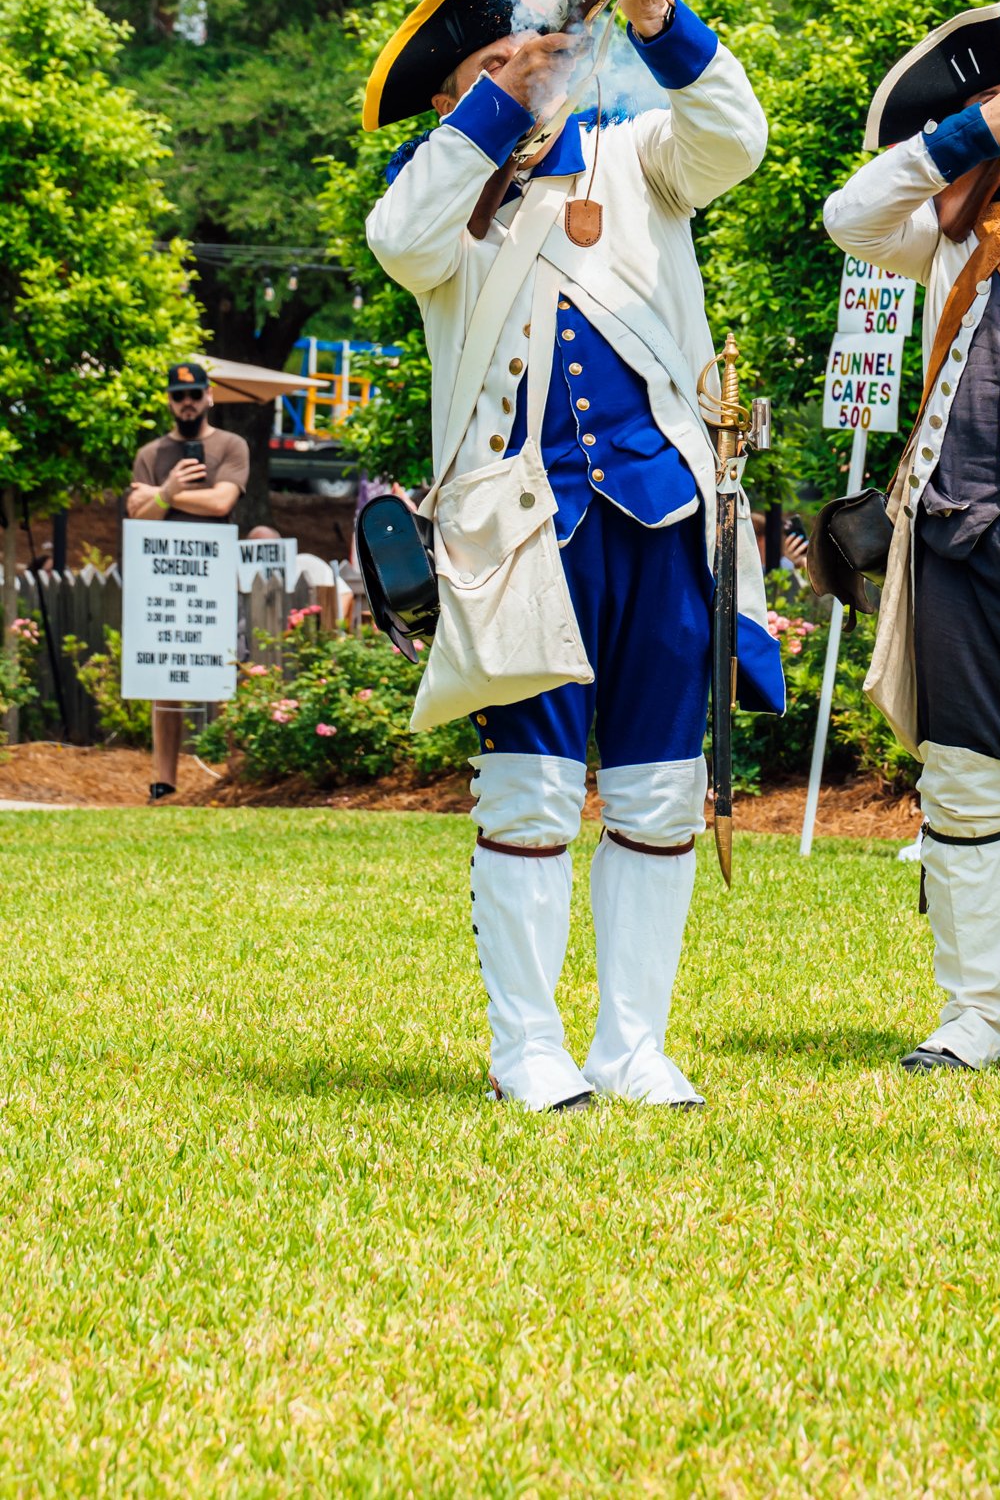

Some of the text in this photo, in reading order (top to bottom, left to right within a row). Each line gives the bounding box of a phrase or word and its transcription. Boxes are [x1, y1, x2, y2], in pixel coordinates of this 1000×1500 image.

[844, 287, 905, 311] CANDY
[831, 351, 895, 376] FUNNEL
[832, 379, 892, 405] CAKES
[143, 537, 219, 557] RUM TASTING
[153, 558, 208, 576] SCHEDULE
[137, 652, 155, 665] SIGN
[159, 653, 168, 665] UP
[190, 654, 224, 668] TASTING
[169, 670, 190, 683] HERE
